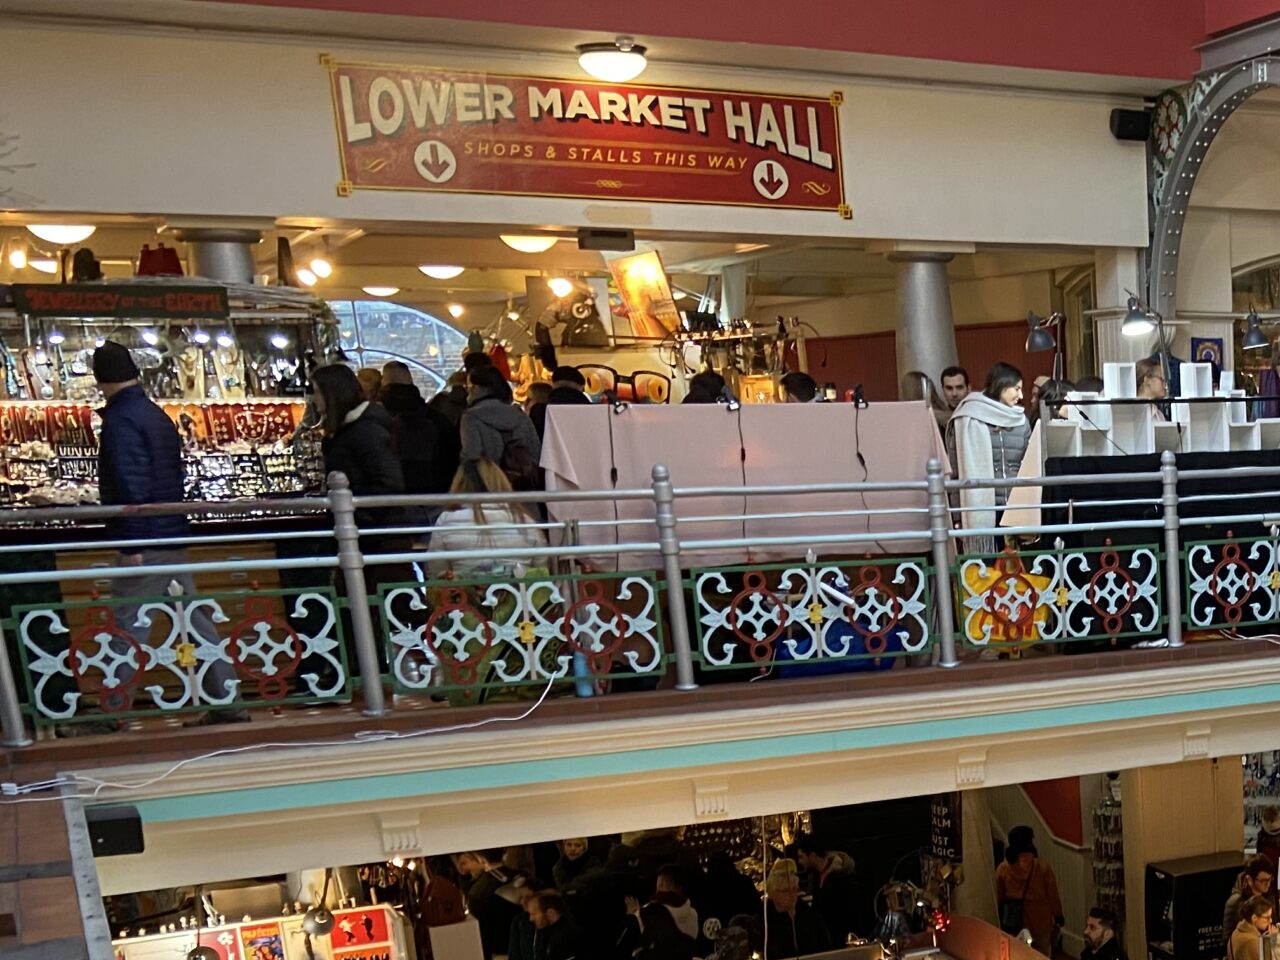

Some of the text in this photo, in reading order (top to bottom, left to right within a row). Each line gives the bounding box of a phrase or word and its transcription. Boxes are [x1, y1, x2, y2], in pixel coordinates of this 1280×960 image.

[339, 75, 833, 169] LOWER MARKET HALL
[464, 141, 748, 170] SHOPS & STALLS THIS WAY
[164, 293, 224, 312] EARTH
[931, 815, 951, 829] ALM
